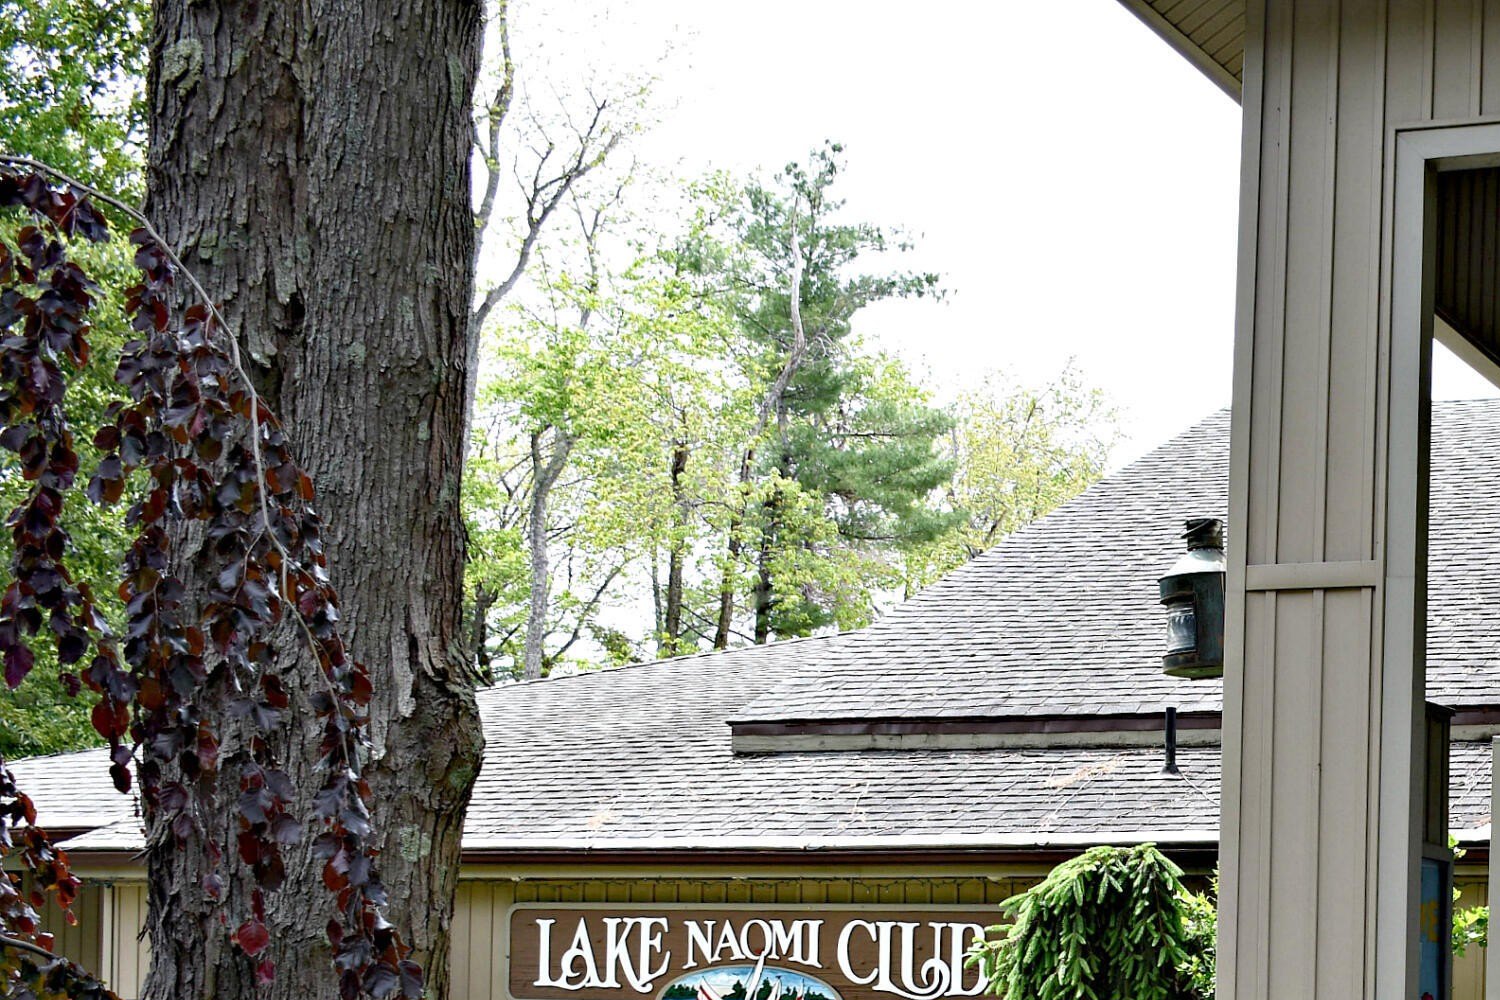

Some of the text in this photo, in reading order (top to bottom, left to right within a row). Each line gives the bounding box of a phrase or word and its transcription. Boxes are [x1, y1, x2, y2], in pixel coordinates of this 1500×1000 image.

[533, 916, 990, 1000] LAKE NAOMI CLUB
